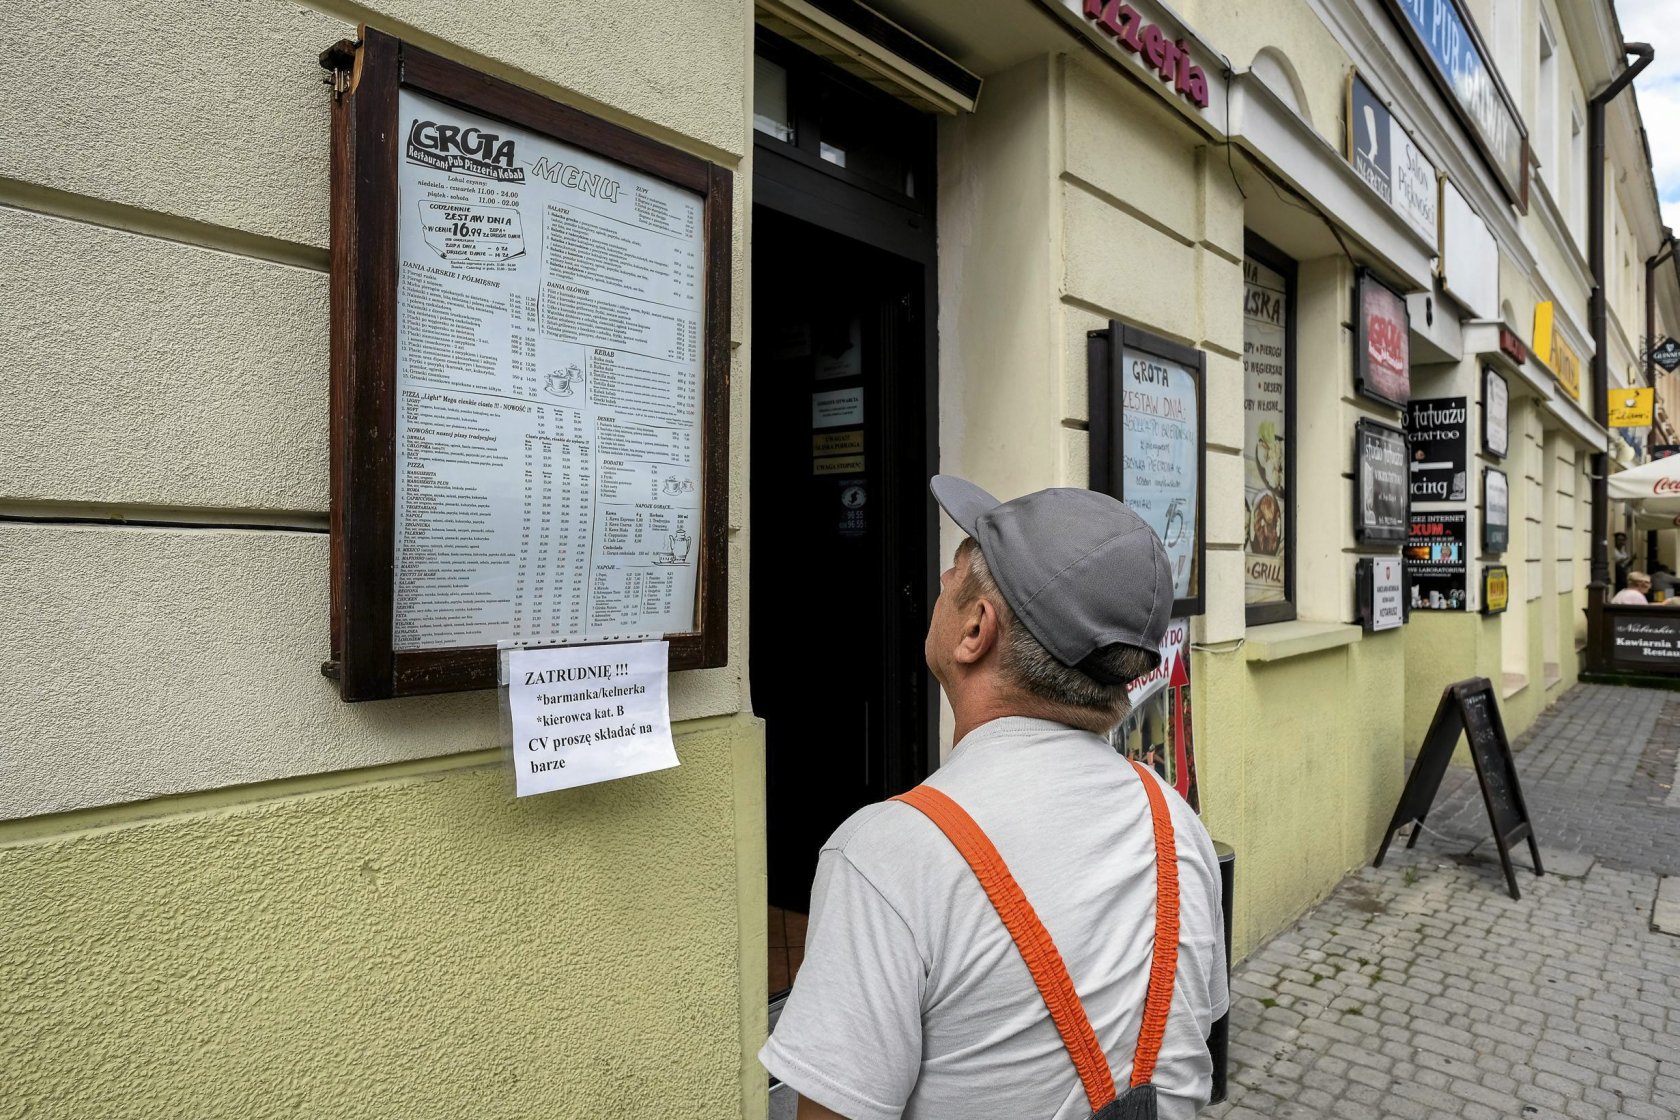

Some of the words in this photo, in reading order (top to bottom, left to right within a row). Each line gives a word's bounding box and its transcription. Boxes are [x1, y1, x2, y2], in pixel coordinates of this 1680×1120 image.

[1431, 0, 1460, 78] PUB
[410, 118, 516, 168] GROTA
[408, 145, 449, 170] Restaurant
[448, 156, 464, 168] Pub
[464, 160, 498, 178] Pizzeria
[498, 167, 524, 179] Kebab
[532, 156, 621, 203] MENU
[417, 180, 445, 190] niedziela
[477, 187, 495, 196] 11.00
[500, 191, 519, 199] 24.00
[429, 203, 472, 213] CODZIENNIE
[478, 196, 496, 205] 11.00
[501, 199, 520, 208] 02.00
[444, 212, 485, 224] ZESTAW
[487, 216, 512, 226] DNIA
[452, 222, 482, 238] 16.99
[402, 260, 426, 272] DANIA
[426, 266, 456, 279] JARSKIE
[462, 274, 501, 288] PÓŁMIĘSNE
[546, 281, 566, 292] DANIA
[1244, 287, 1281, 325] LSKA
[594, 348, 615, 358] KEBAB
[1259, 344, 1282, 358] PIEROGI
[1132, 360, 1170, 388] GROTA
[1264, 381, 1283, 395] DESERY
[402, 390, 420, 399] PIZZA
[443, 396, 457, 404] Mega
[502, 402, 527, 414] NOWOŚĆ
[1123, 390, 1158, 412] ZESTAW
[1413, 401, 1466, 430] tatuażu
[406, 426, 436, 436] NOWOŚCI
[1408, 430, 1460, 442] GTATTOO
[1428, 514, 1465, 522] INTERNET
[1408, 523, 1444, 536] XUM
[1252, 561, 1282, 584] GRILL
[1170, 628, 1183, 646] DO
[1616, 638, 1672, 648] Kawiarnia
[524, 664, 612, 686] ZATRUDNIĘ
[616, 663, 629, 676] !!!
[594, 707, 614, 719] kat.
[616, 704, 625, 717] B
[528, 736, 549, 752] CV
[552, 732, 592, 752] proszę
[594, 724, 636, 742] składać
[639, 724, 653, 734] na
[530, 758, 566, 774] barze
